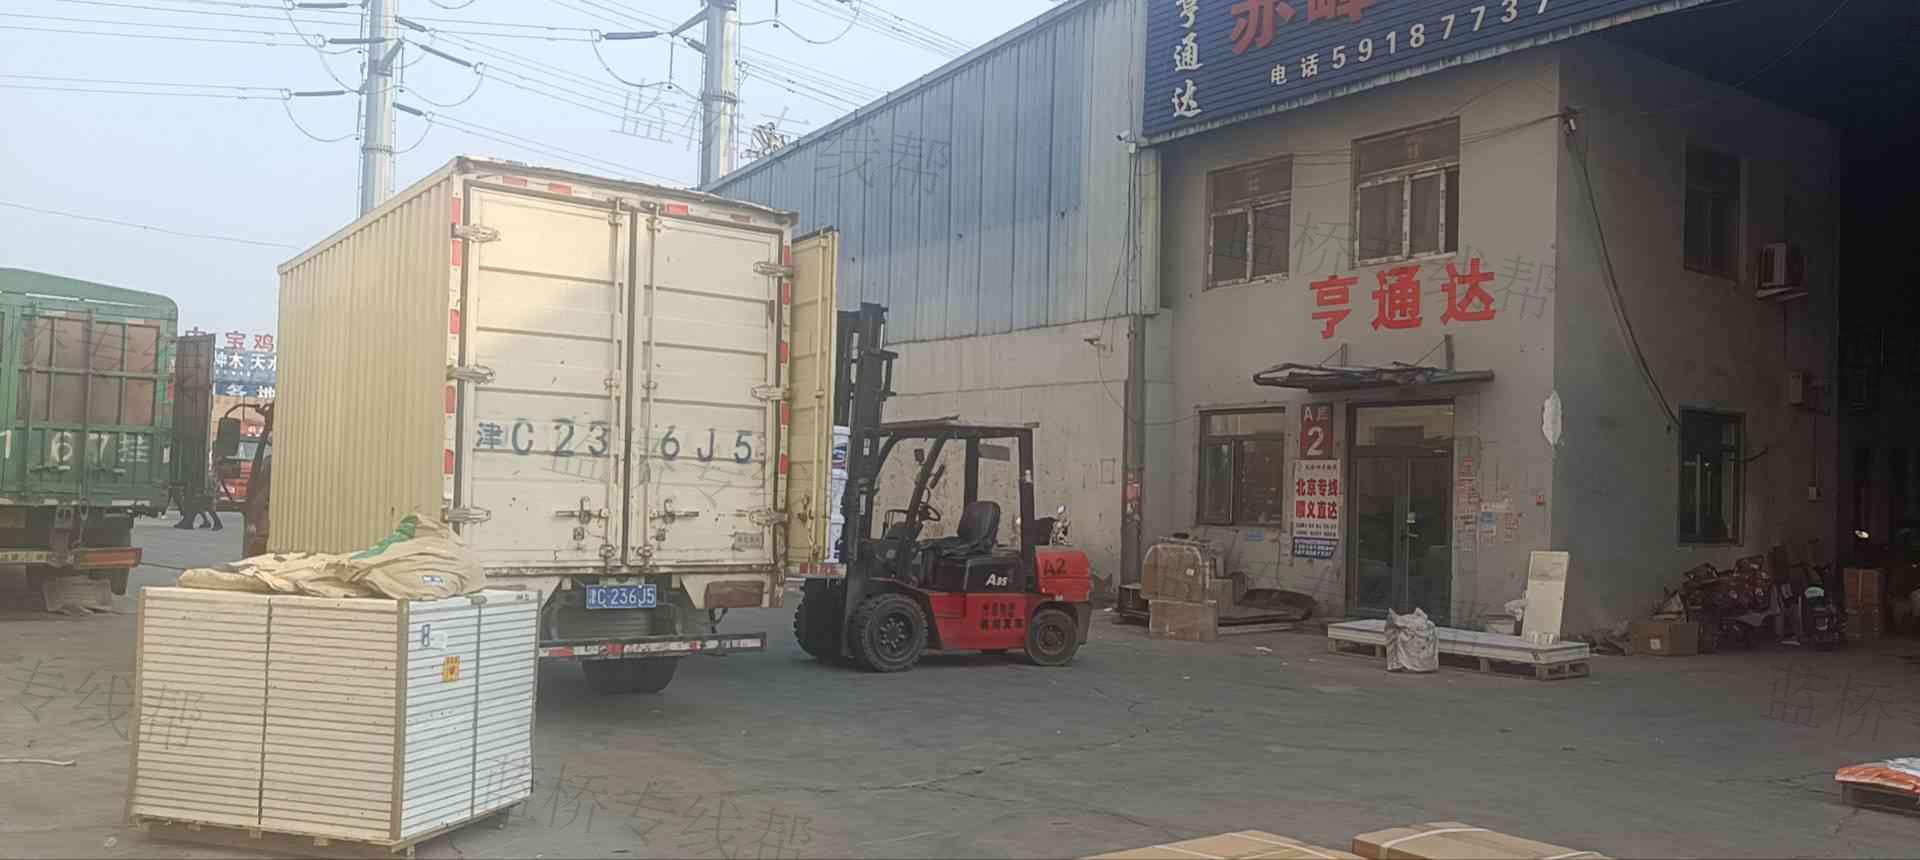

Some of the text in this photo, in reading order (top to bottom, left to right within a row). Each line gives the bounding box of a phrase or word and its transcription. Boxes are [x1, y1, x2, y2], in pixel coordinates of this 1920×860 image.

[1270, 54, 1319, 85] 电话
[1310, 258, 1496, 340] 亨通达
[1306, 427, 1324, 456] 2
